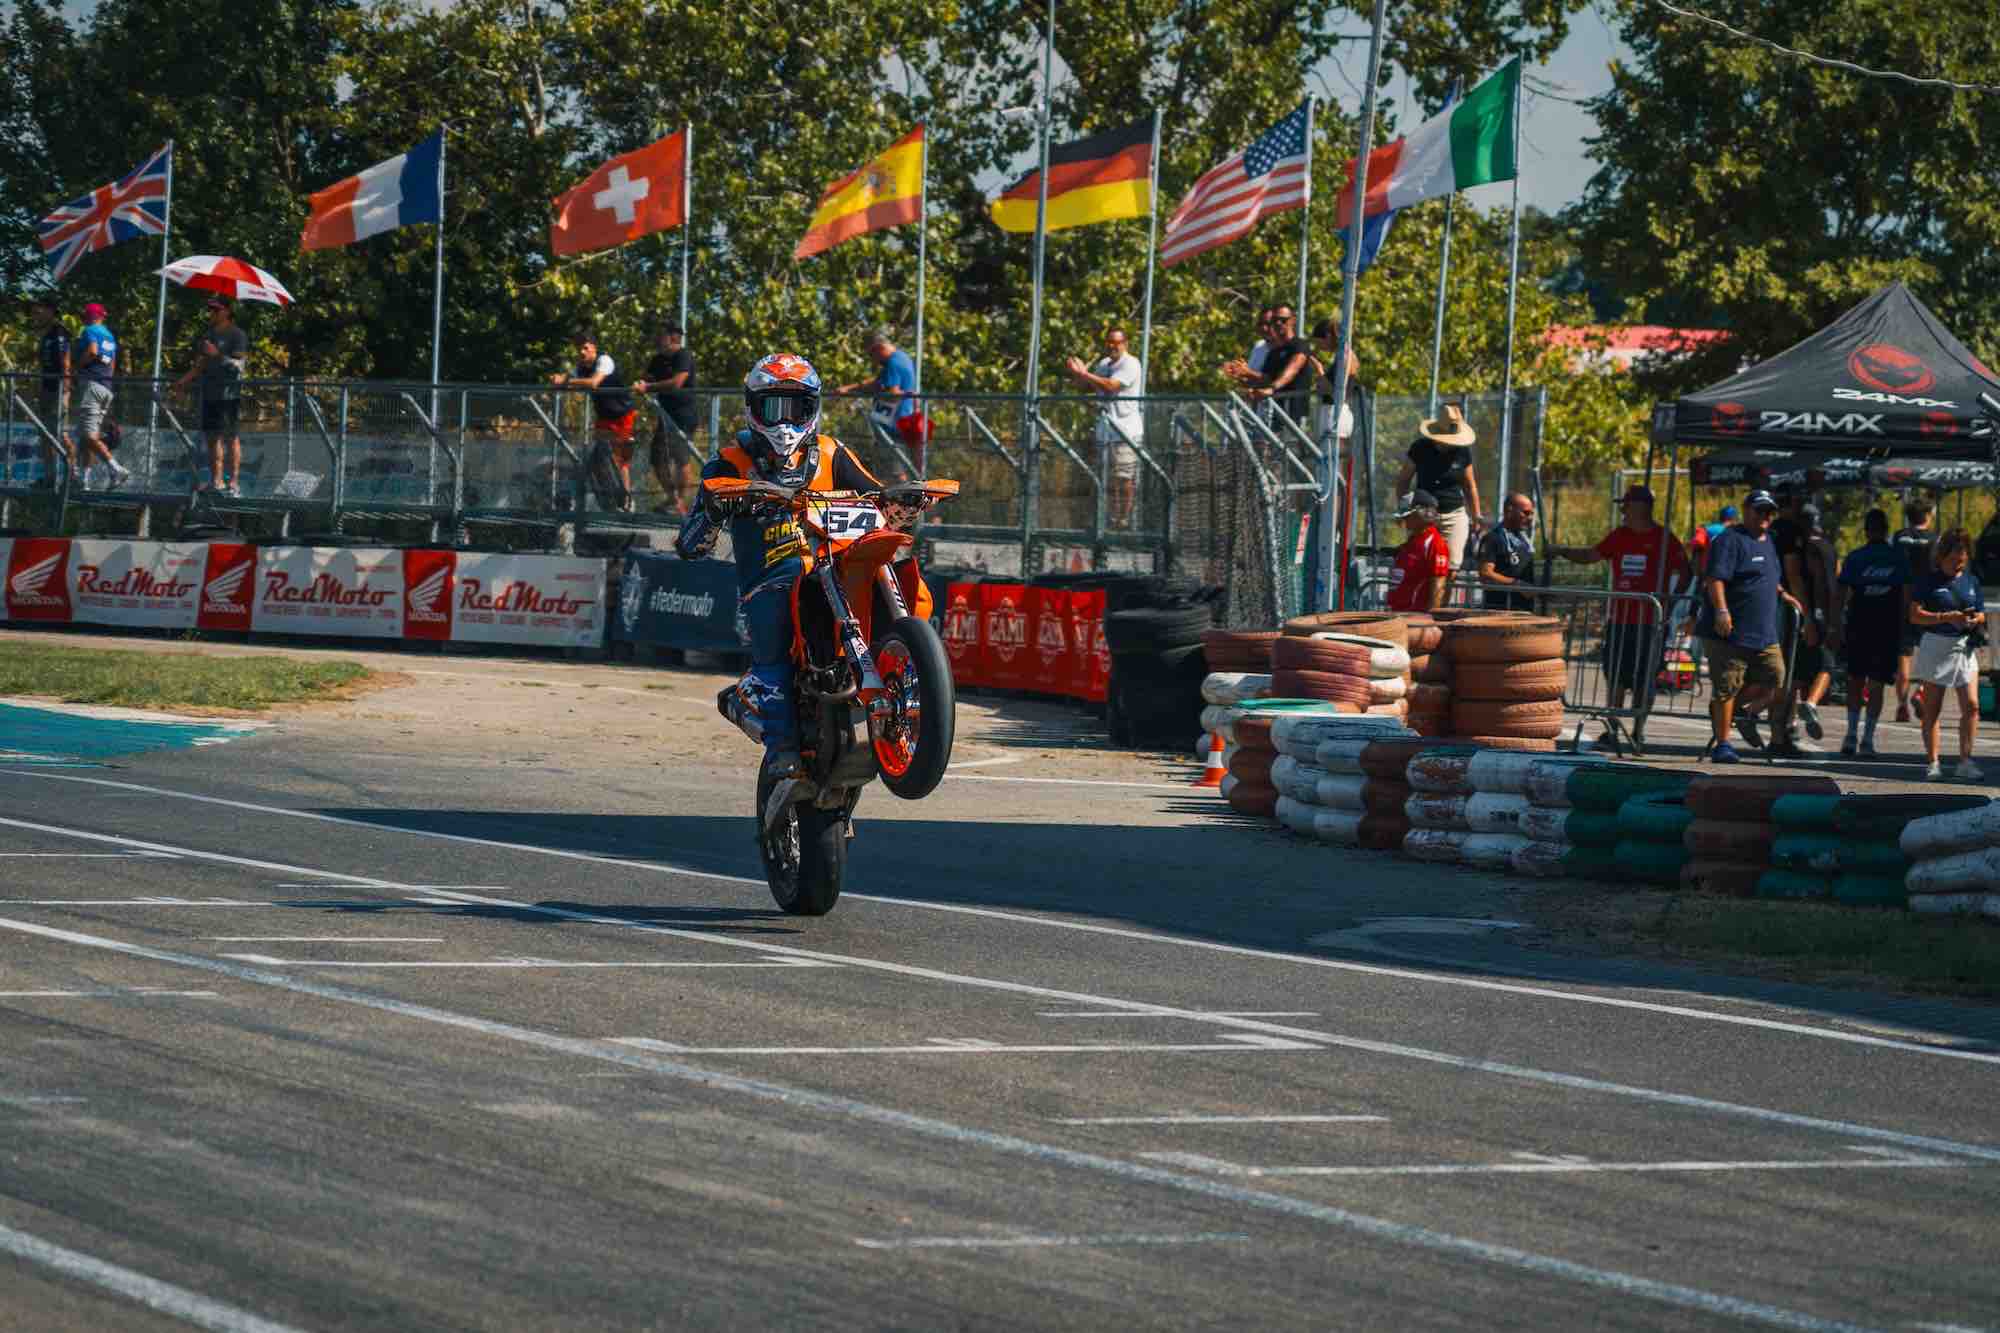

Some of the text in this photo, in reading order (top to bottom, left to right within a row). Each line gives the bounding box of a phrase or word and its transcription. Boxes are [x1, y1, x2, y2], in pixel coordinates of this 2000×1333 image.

[1832, 388, 1959, 408] 24MX
[1760, 411, 1884, 433] 24MX
[824, 510, 877, 534] 54
[77, 563, 197, 598] RedMoto
[263, 571, 397, 606] RedMoto
[460, 578, 595, 616] RedMoto
